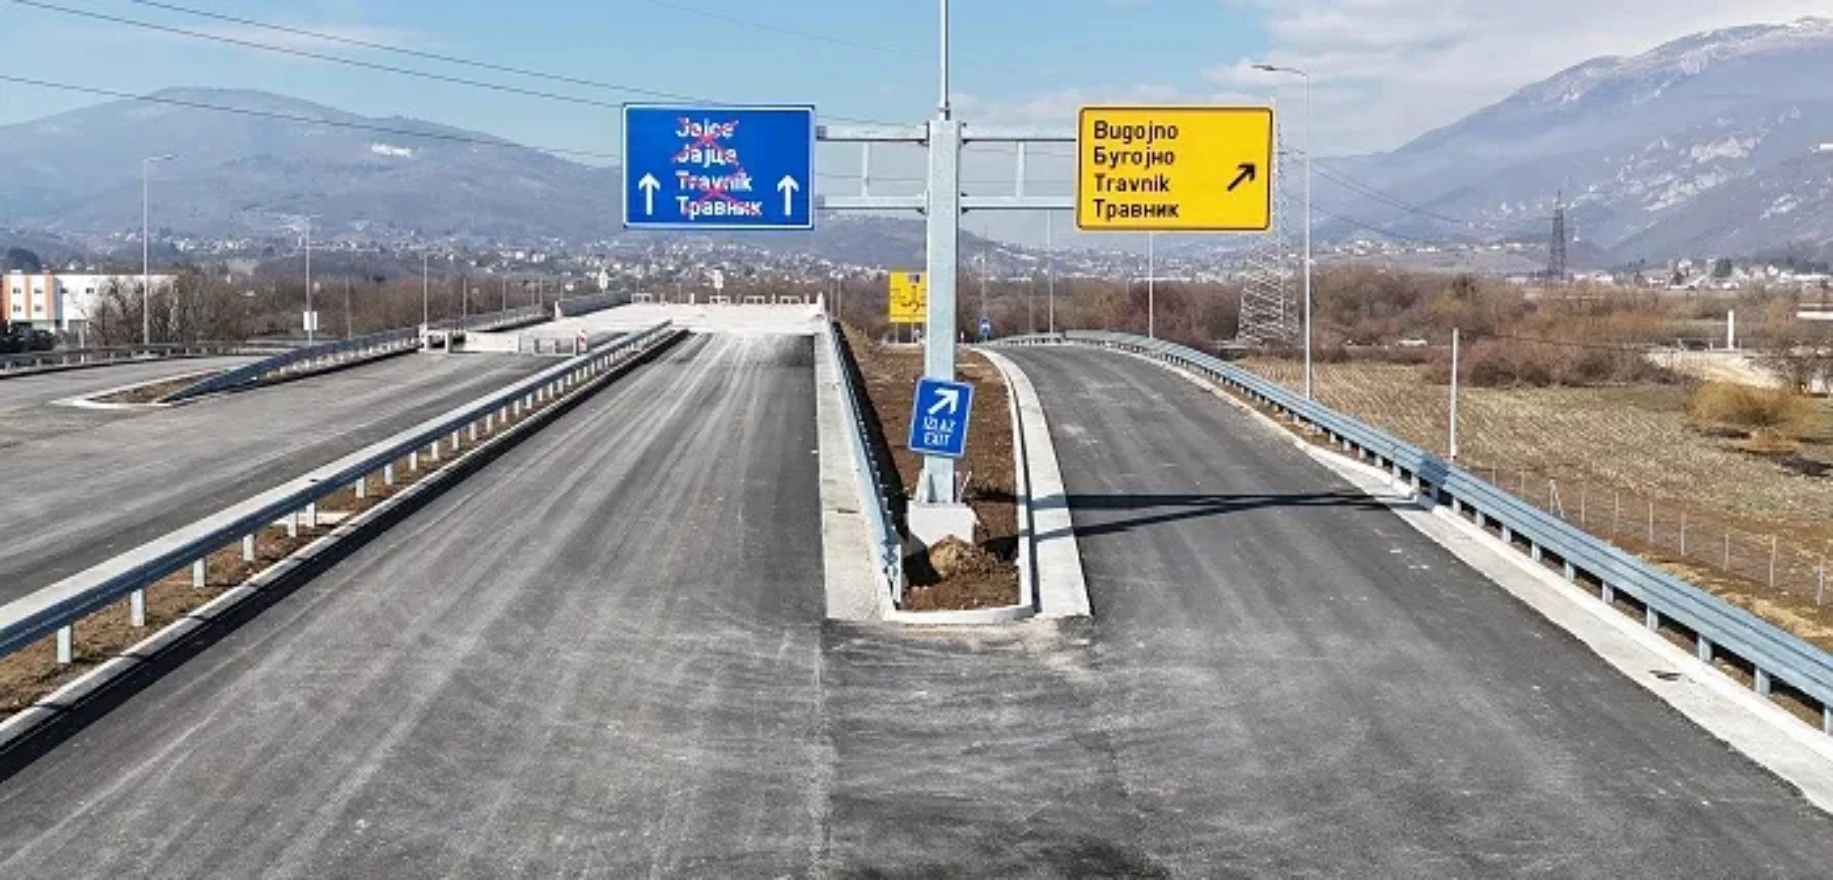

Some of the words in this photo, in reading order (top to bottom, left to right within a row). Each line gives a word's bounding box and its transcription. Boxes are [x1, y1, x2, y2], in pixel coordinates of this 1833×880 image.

[676, 117, 735, 140] Jajce
[1094, 120, 1179, 144] Bugojno
[1094, 147, 1175, 169] Бугојно
[675, 170, 753, 191] Travnik
[1094, 173, 1170, 192] Travnik
[675, 196, 763, 220] Травник
[1093, 198, 1180, 222] Травник
[924, 416, 956, 433] IZLAZ
[924, 432, 951, 446] EXIT
